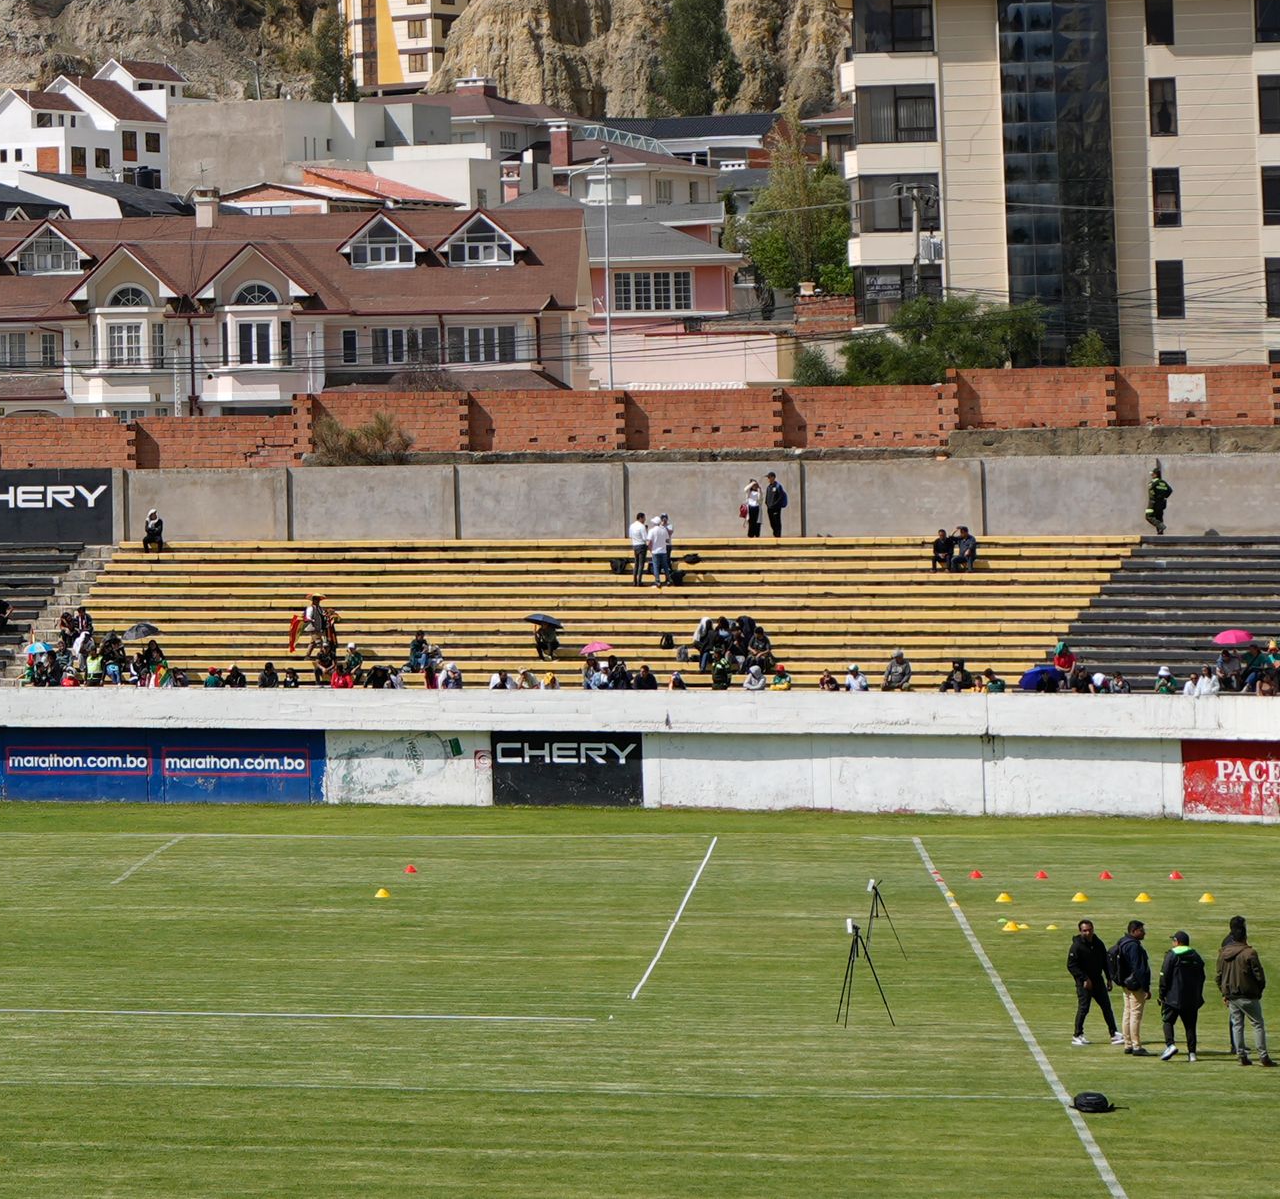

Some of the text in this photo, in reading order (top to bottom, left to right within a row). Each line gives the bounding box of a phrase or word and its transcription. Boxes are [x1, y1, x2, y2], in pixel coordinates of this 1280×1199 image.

[496, 742, 638, 764] CHERY
[8, 754, 148, 768] marathon.com.bo
[165, 755, 306, 770] marathon.com.bo
[1217, 784, 1244, 794] SIN
